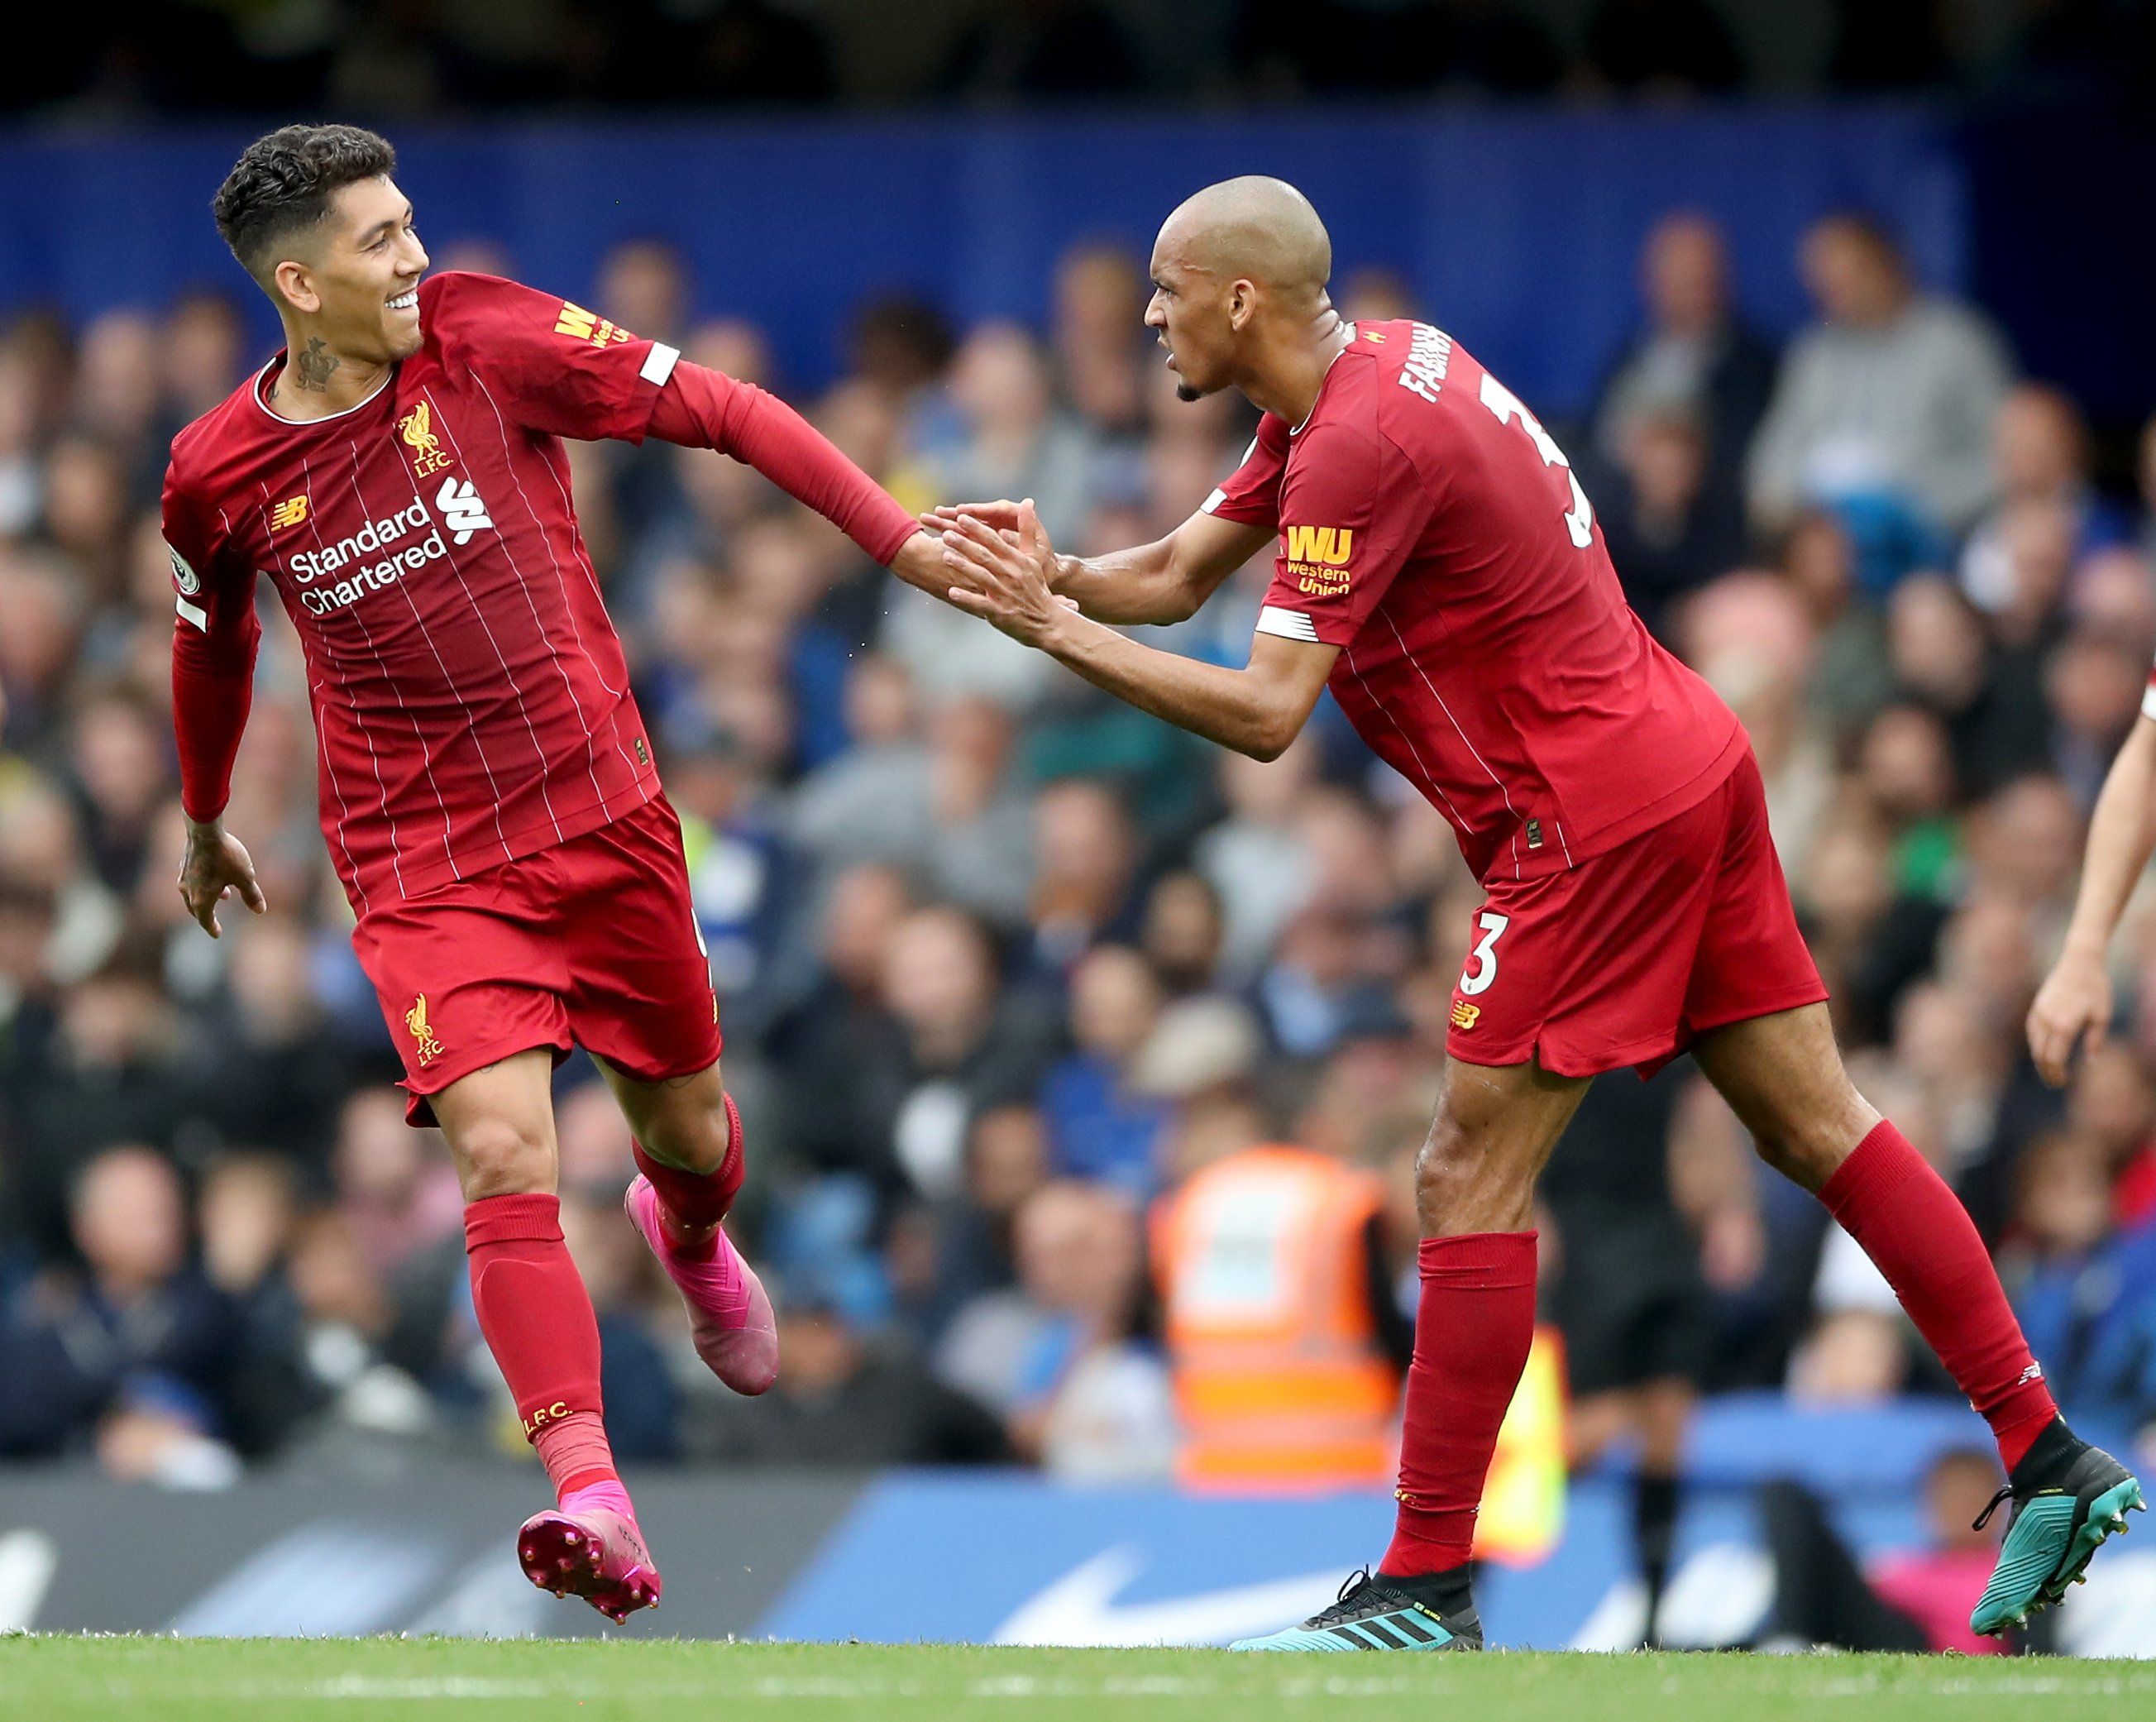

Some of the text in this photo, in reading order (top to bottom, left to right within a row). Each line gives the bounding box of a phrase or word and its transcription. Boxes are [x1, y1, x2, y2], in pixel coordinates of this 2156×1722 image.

[290, 495, 431, 583] Standard
[301, 528, 447, 615] Chartered
[1288, 525, 1353, 565] WU
[1298, 577, 1350, 596] Union
[1460, 912, 1509, 996] 3
